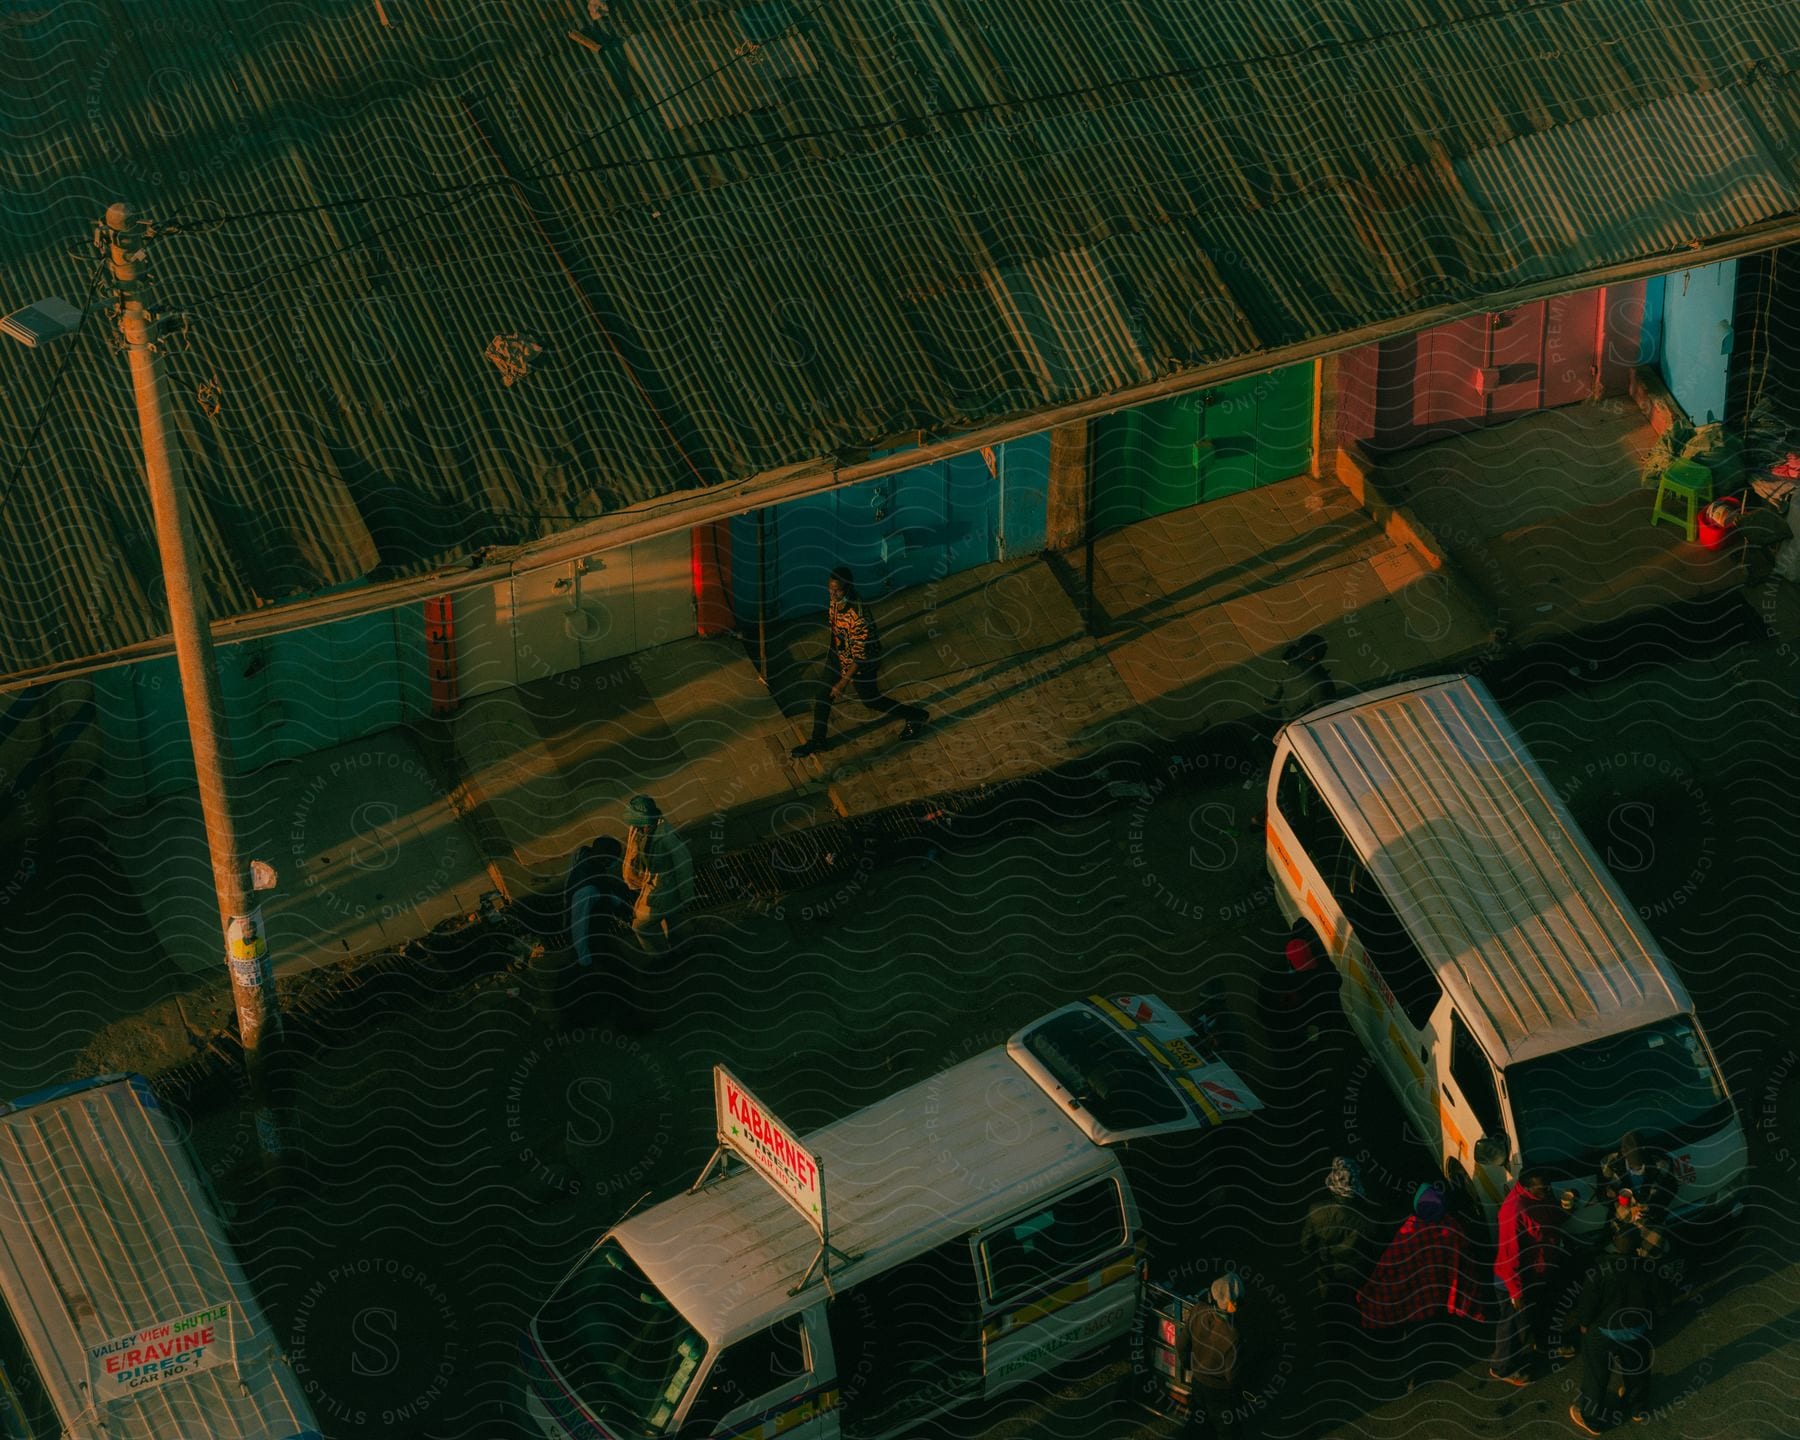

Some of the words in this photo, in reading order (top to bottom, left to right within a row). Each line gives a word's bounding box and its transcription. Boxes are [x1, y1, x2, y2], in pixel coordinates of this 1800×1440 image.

[726, 1084, 815, 1192] KABARNET
[743, 1127, 805, 1190] DIRECT
[92, 1335, 137, 1358] VALLEY
[139, 1325, 171, 1344] VIEW
[173, 1305, 228, 1333] SHUTTLE
[106, 1326, 215, 1375] E/RAVINE
[998, 1326, 1082, 1377] TRANSVALLEY
[1083, 1308, 1124, 1336] SACCO
[117, 1346, 206, 1383] DIRECT
[129, 1372, 159, 1388] CAR
[163, 1365, 189, 1379] NO.
[193, 1360, 200, 1368] 1
